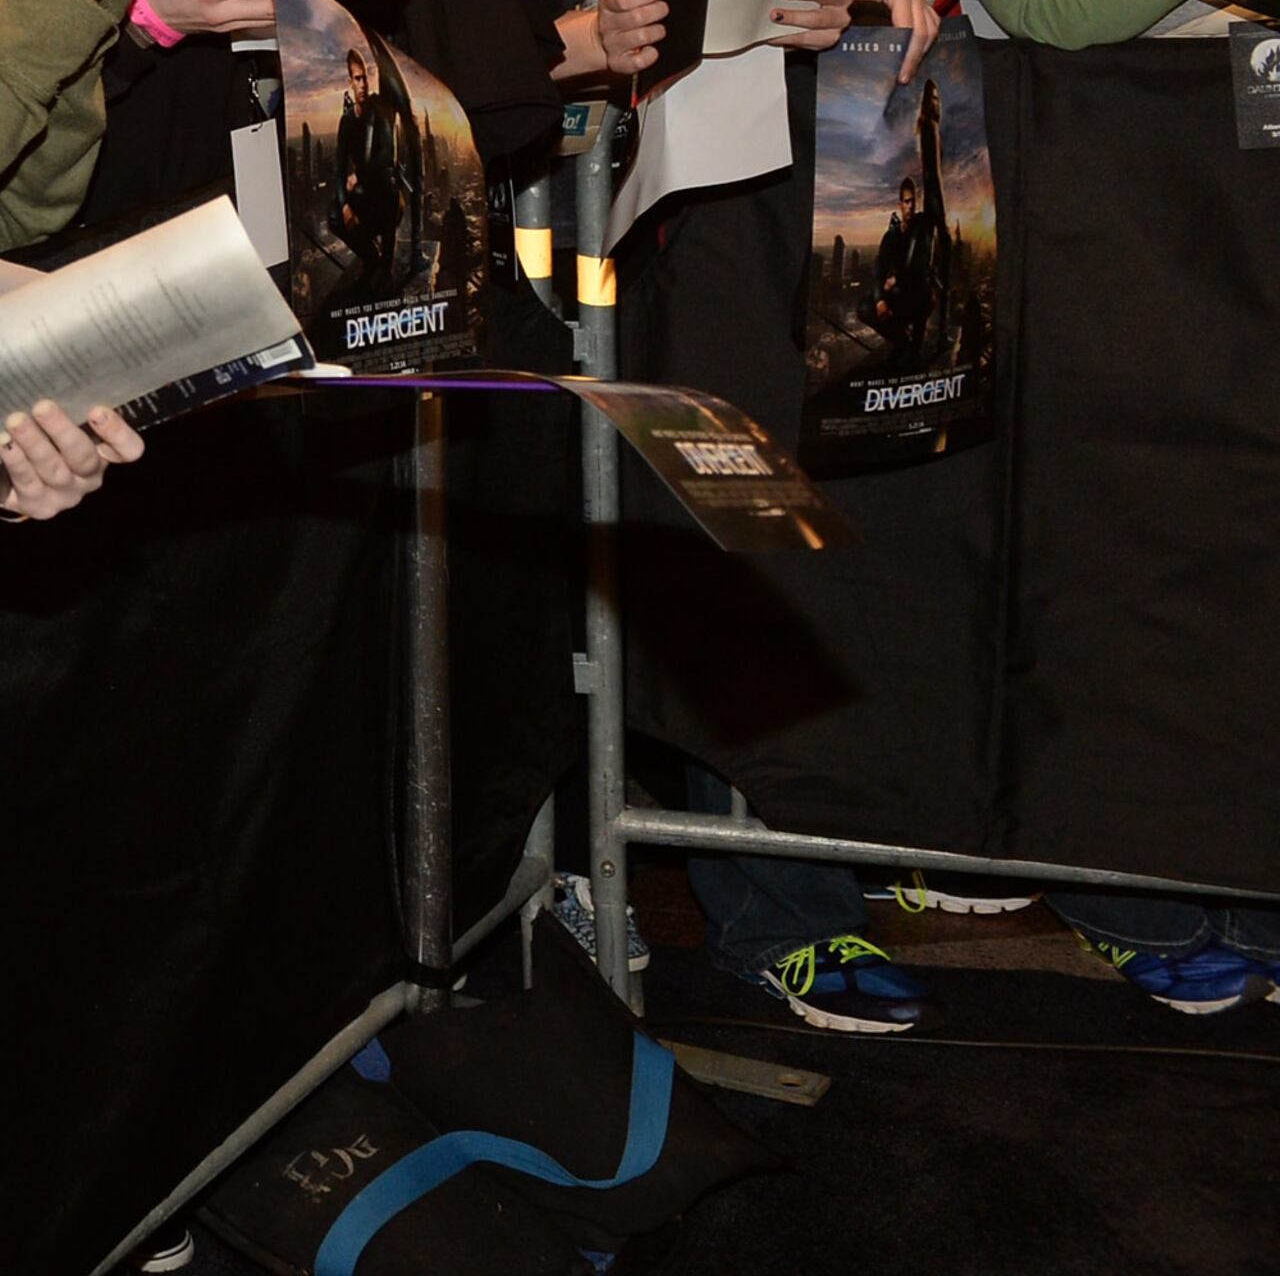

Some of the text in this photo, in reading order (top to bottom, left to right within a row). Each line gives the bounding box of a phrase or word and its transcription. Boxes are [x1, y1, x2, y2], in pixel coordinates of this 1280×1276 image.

[842, 42, 880, 53] BASED
[889, 43, 903, 53] ON
[346, 302, 448, 349] DIVERGENT
[864, 374, 966, 412] DIVERGENT
